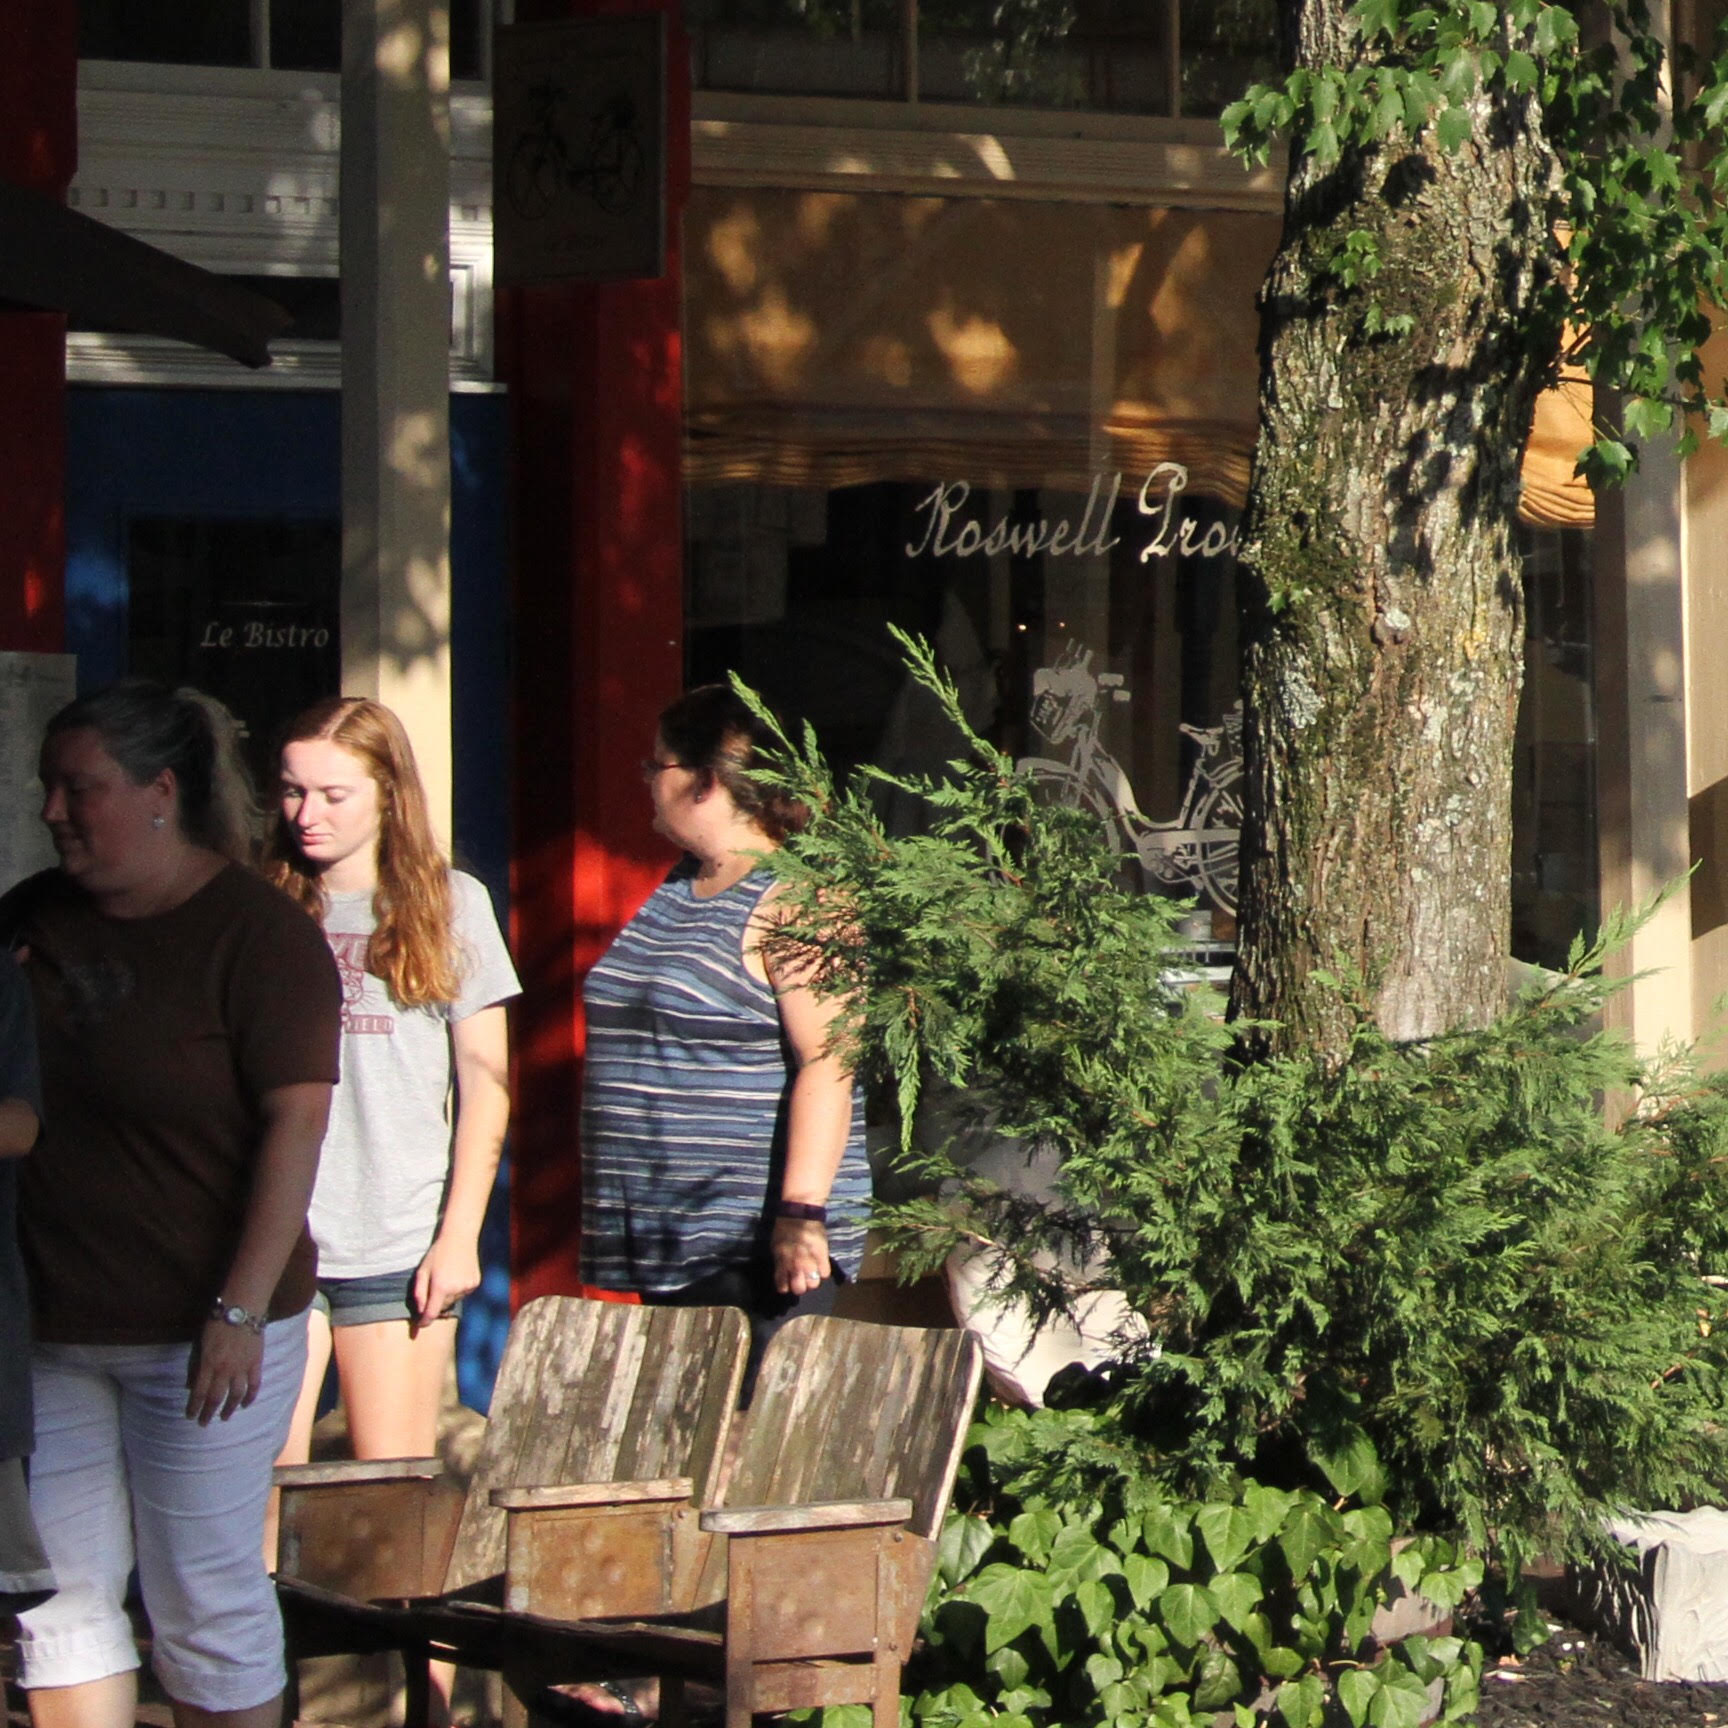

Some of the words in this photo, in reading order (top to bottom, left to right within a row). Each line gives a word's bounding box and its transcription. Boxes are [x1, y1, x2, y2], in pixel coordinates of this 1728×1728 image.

[905, 472, 1122, 559] Roswell
[200, 622, 233, 648] Le
[243, 621, 330, 649] Bistro
